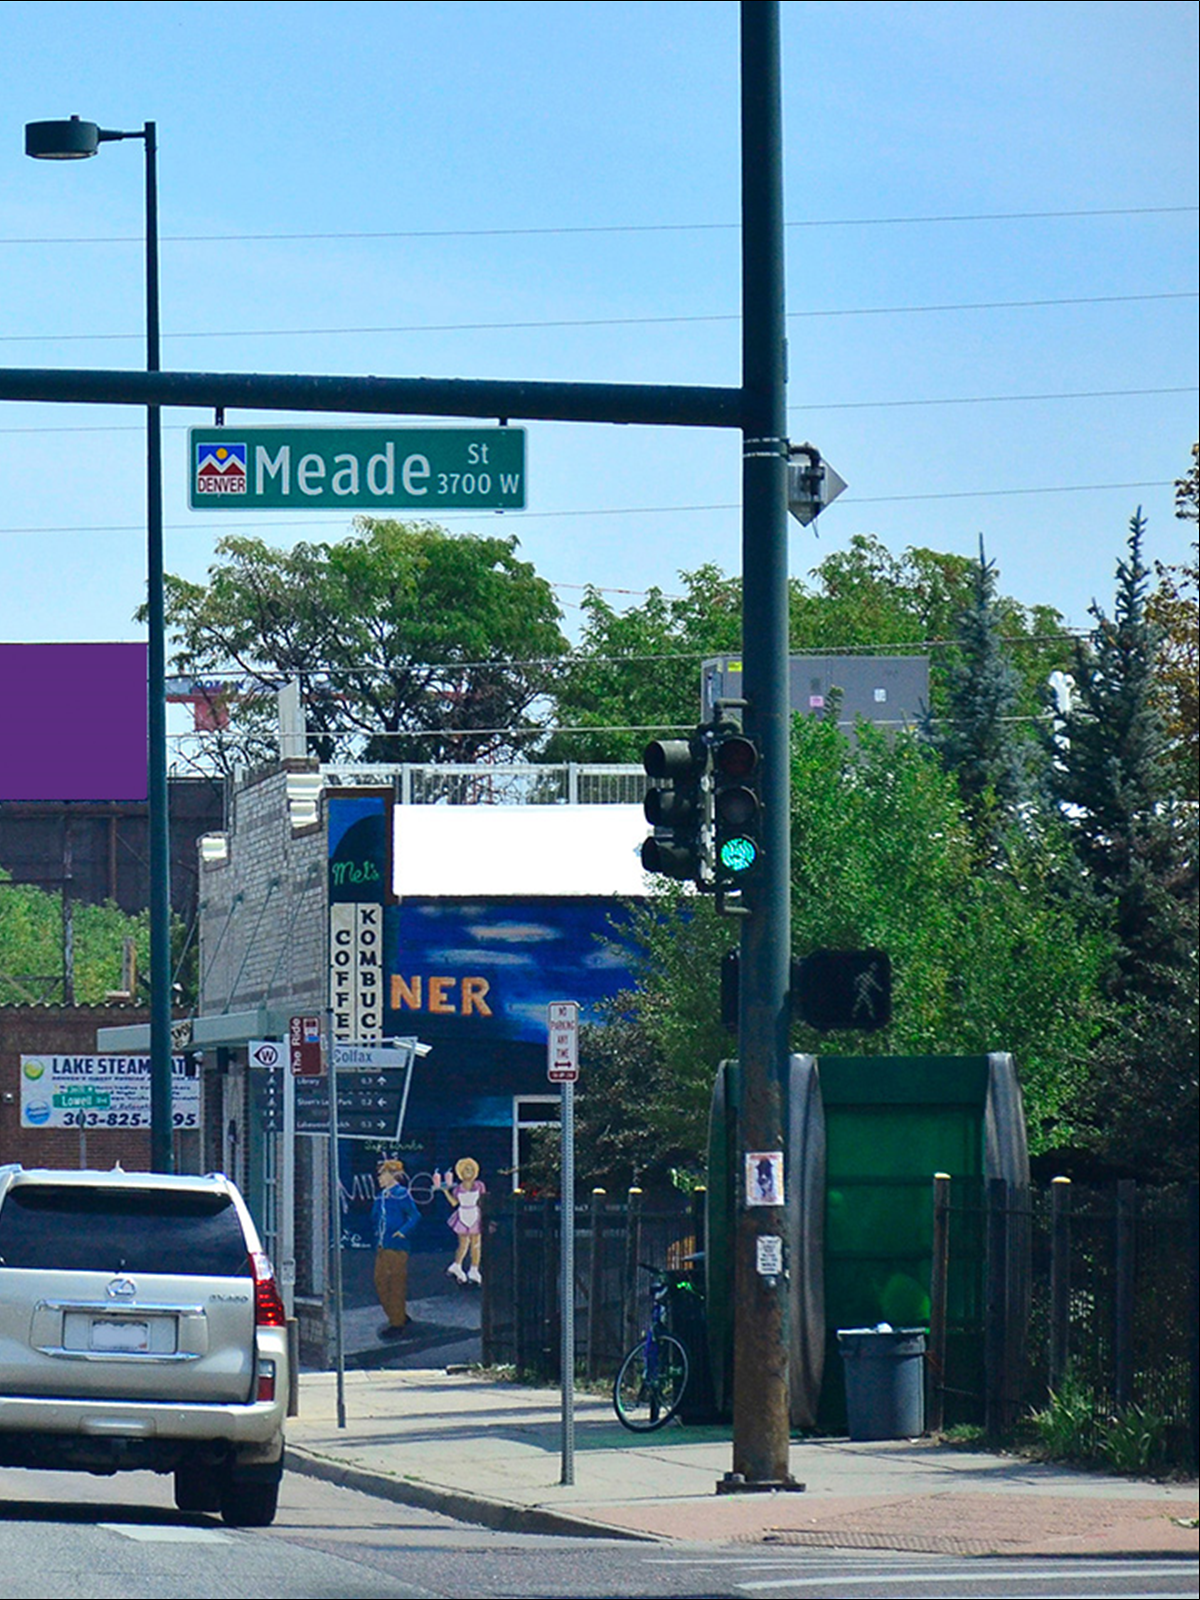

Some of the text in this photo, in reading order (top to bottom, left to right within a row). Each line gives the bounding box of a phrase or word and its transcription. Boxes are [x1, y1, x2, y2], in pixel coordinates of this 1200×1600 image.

[467, 443, 490, 465] St
[255, 442, 431, 496] Meade
[198, 477, 246, 493] DENVER
[437, 473, 519, 495] 3700 W
[332, 861, 380, 886] Mel's
[359, 909, 377, 1048] KOMBUCH
[390, 974, 493, 1018] NER
[52, 1058, 151, 1074] LAKE STEAM
[292, 1051, 302, 1073] The
[334, 1048, 373, 1063] Colfax
[61, 1095, 93, 1107] Lowell
[63, 1112, 196, 1126] 303-825-95
